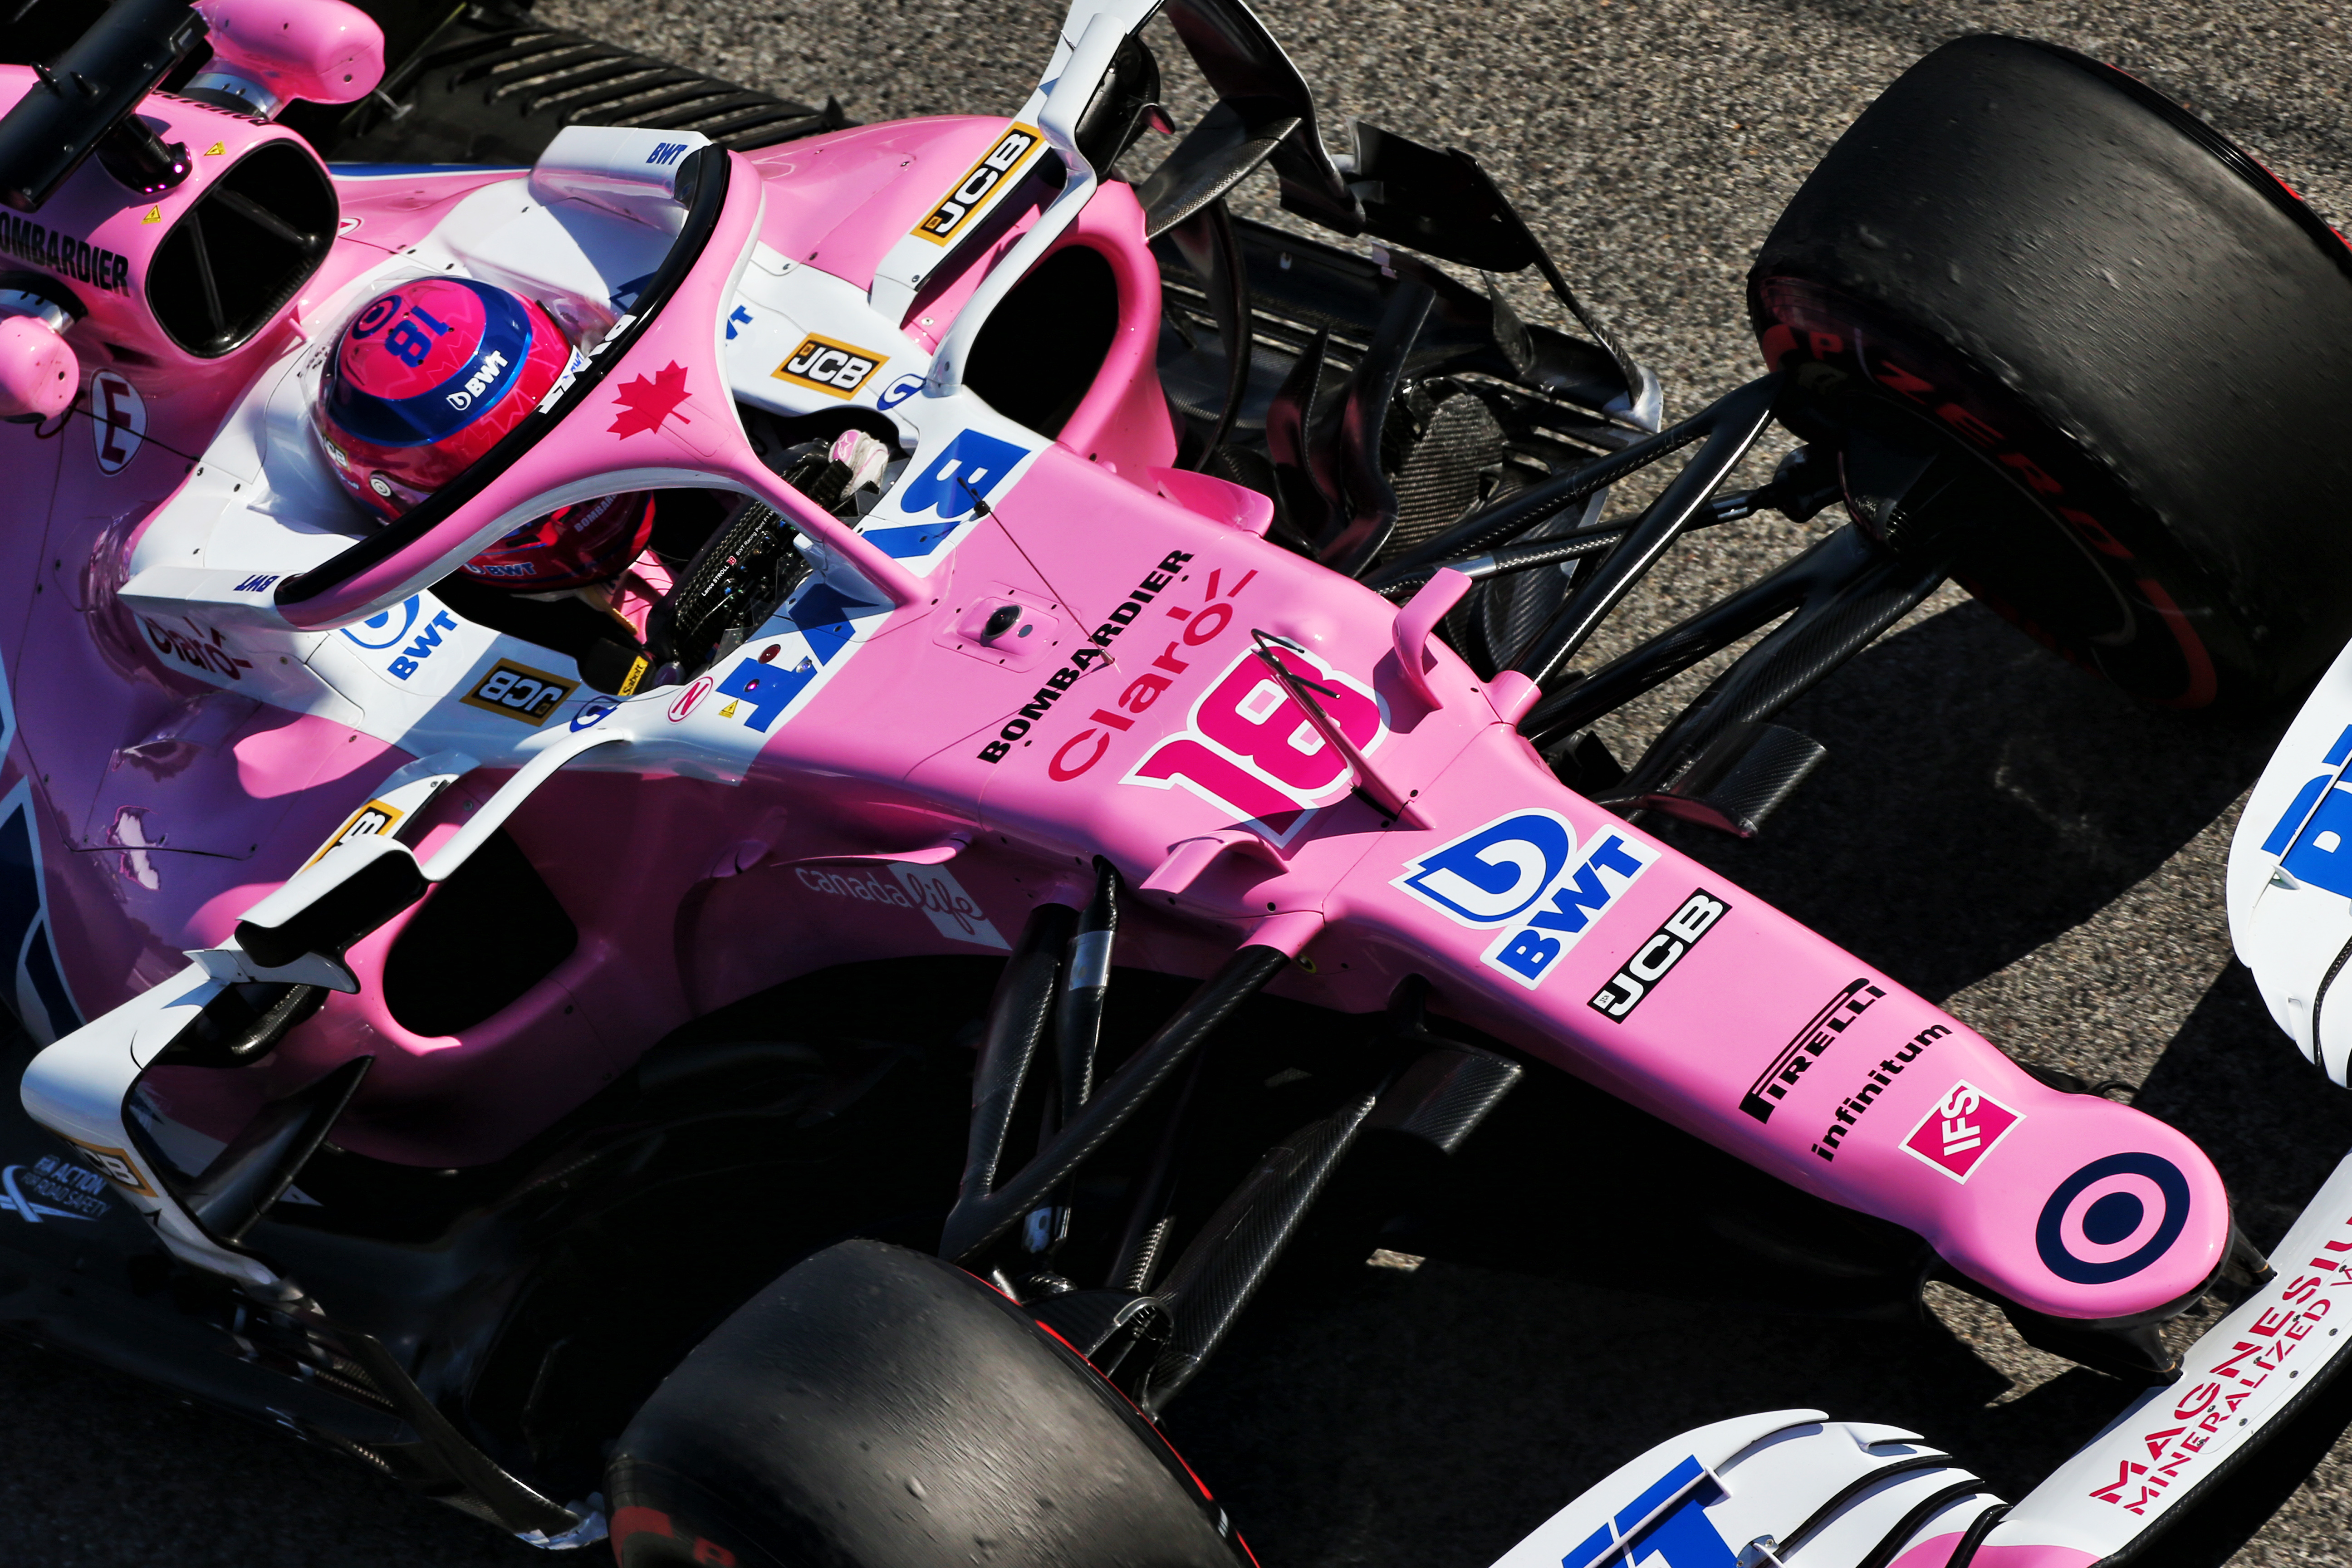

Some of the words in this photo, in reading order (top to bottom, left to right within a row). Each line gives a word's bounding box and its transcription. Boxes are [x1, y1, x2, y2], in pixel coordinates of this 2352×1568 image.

[646, 142, 689, 165] BWT
[935, 133, 1031, 233] JCB
[0, 211, 130, 298] OMBARDIER
[385, 305, 451, 368] 18
[787, 347, 873, 389] JCB
[465, 350, 508, 398] BWT
[100, 378, 131, 465] E
[233, 575, 280, 592] BWT
[483, 562, 536, 576] BWT
[701, 582, 715, 597] Lance
[713, 565, 730, 583] STROLL
[735, 545, 745, 556] BWT
[744, 531, 757, 546] Racing
[755, 521, 765, 532] Point
[387, 610, 458, 681] BWT
[623, 664, 643, 695] Sabelt
[977, 549, 1196, 764] BOMBARDIER
[479, 671, 563, 711] JCB
[671, 682, 710, 715] N
[1048, 601, 1234, 782] Claro
[1123, 641, 1386, 844] 18
[795, 867, 915, 908] canada
[906, 872, 987, 936] life
[1496, 834, 1643, 980] BWT
[1608, 895, 1723, 1016] JCB
[1738, 978, 1887, 1124] PIRELLI
[1810, 1024, 1953, 1162] infinitum
[1940, 1088, 1982, 1156] IFS
[34, 1180, 70, 1201] ROAD
[64, 1191, 113, 1216] SAFETY
[50, 1163, 108, 1196] ACTION
[76, 1145, 139, 1186] CB
[2124, 1299, 2330, 1515] MINERALIZED
